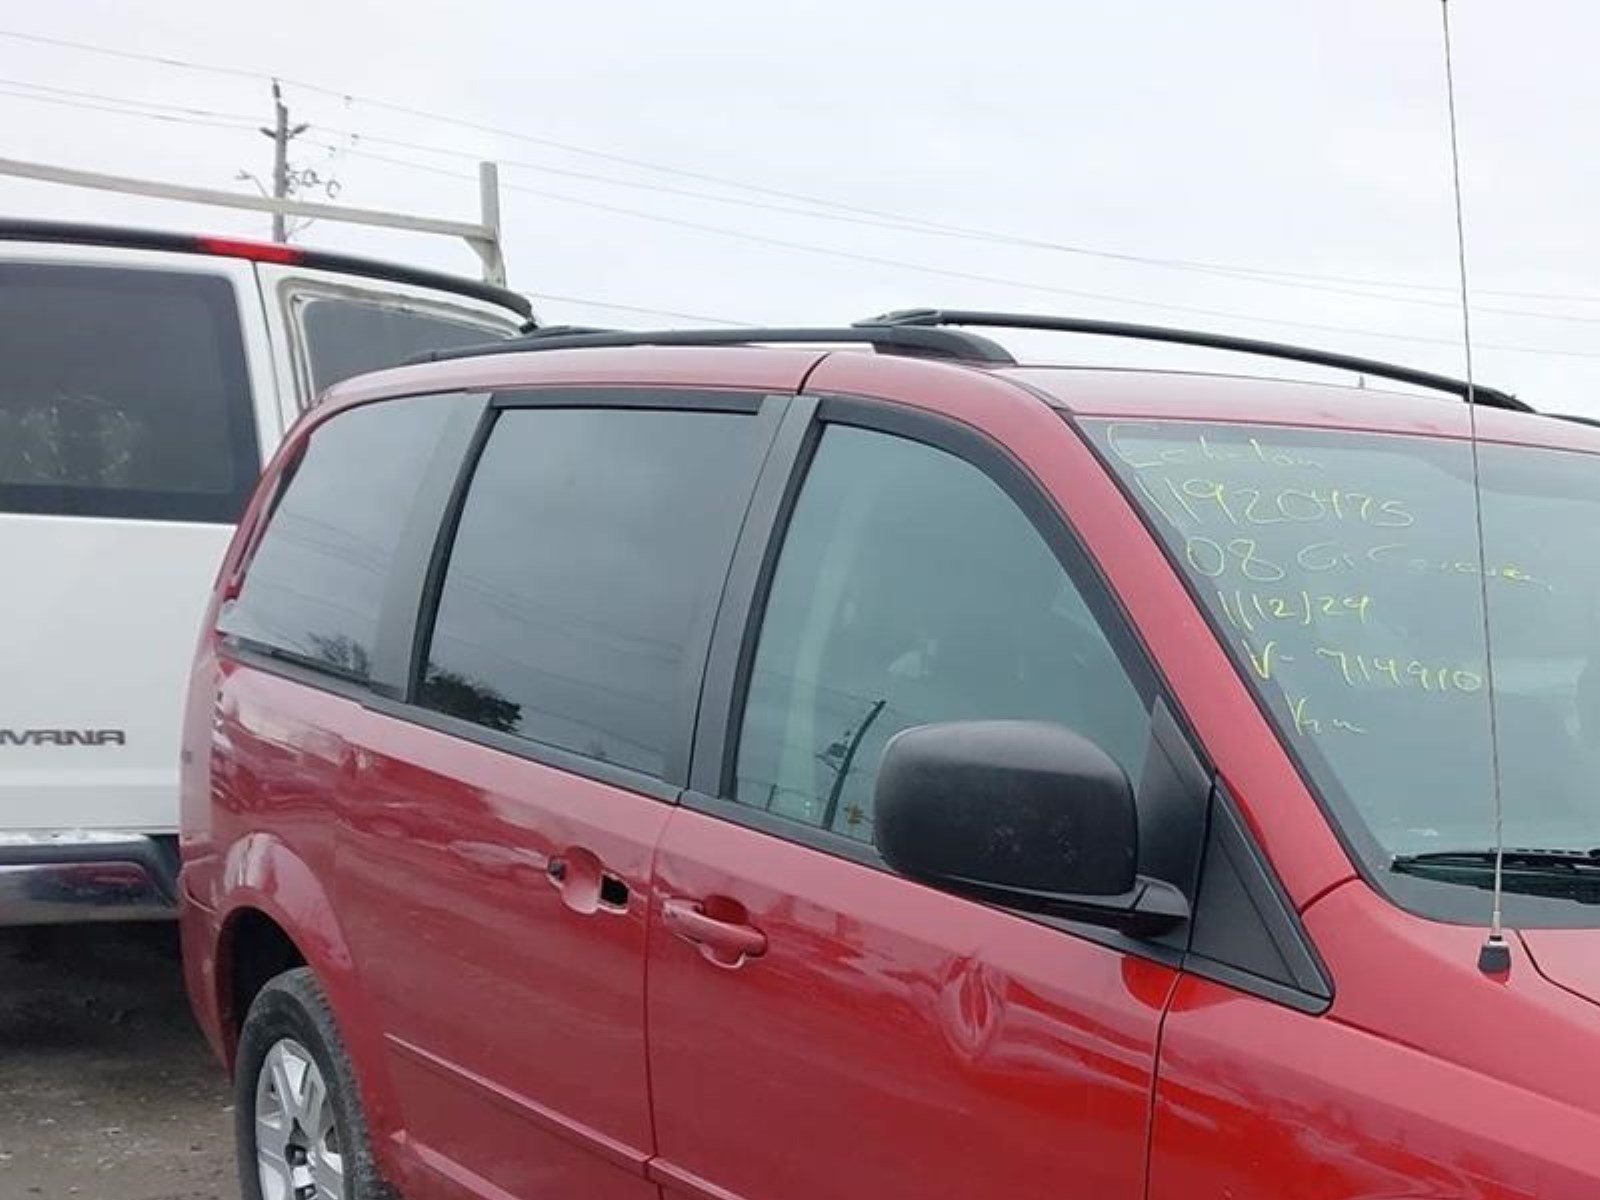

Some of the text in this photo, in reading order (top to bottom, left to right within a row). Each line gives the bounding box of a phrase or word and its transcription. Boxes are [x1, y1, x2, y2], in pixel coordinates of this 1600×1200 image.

[1132, 476, 1414, 527] 11920475
[1187, 537, 1285, 581] 08
[0, 729, 126, 746] VANA
